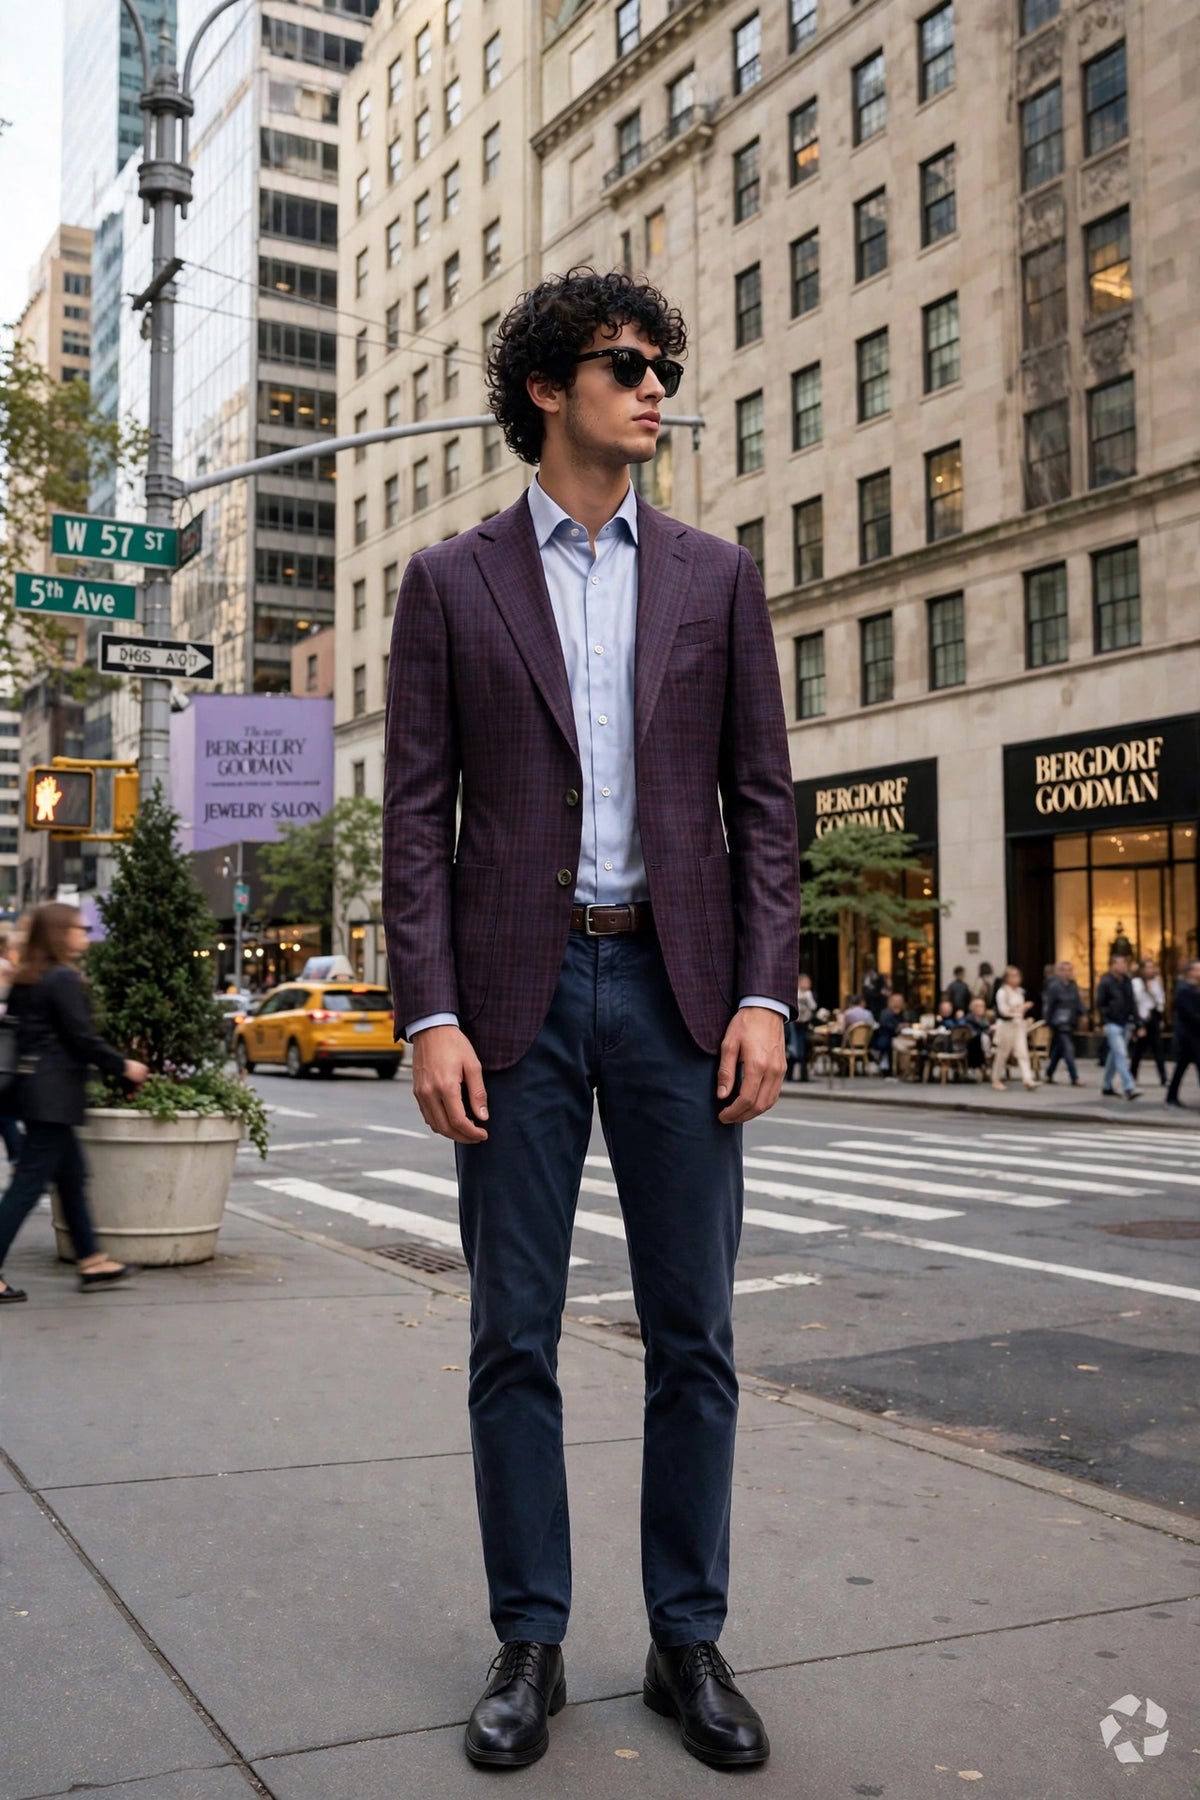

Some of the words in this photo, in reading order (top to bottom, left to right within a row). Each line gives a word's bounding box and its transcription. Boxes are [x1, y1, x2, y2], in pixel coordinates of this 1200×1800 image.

[65, 520, 88, 552] W
[101, 524, 134, 558] 57
[144, 531, 165, 551] ST
[30, 579, 64, 607] 5th
[72, 585, 116, 614] Ave
[1035, 736, 1164, 785] BERGDORF
[203, 802, 266, 824] JEWELRY
[271, 800, 321, 818] SALON
[815, 776, 909, 816] BERGDORF
[1035, 771, 1159, 815] GOODMAN
